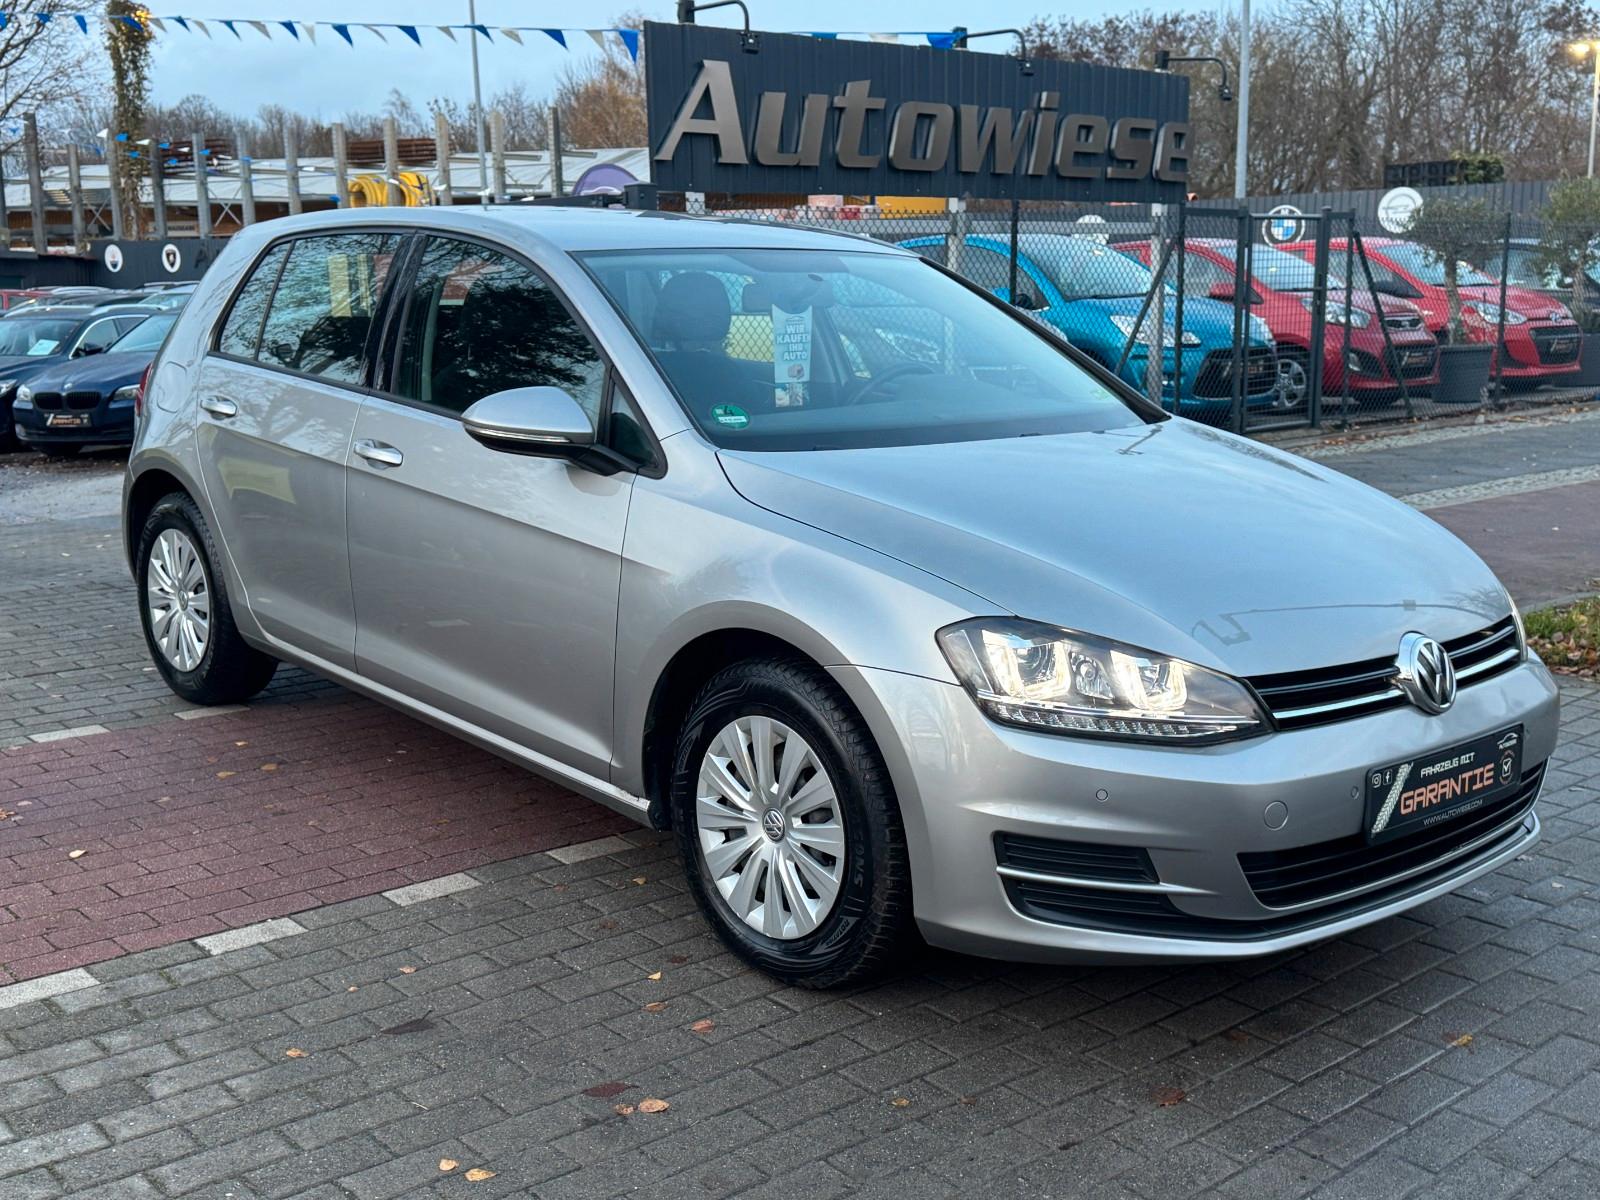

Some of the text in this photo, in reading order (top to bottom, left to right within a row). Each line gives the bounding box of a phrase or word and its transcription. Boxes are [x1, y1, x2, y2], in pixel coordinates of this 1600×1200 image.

[655, 59, 1192, 183] Autowiese
[783, 351, 807, 361] AUTO
[1420, 752, 1475, 778] FAHRZEUG MIT
[1401, 763, 1494, 814] GARANTIE
